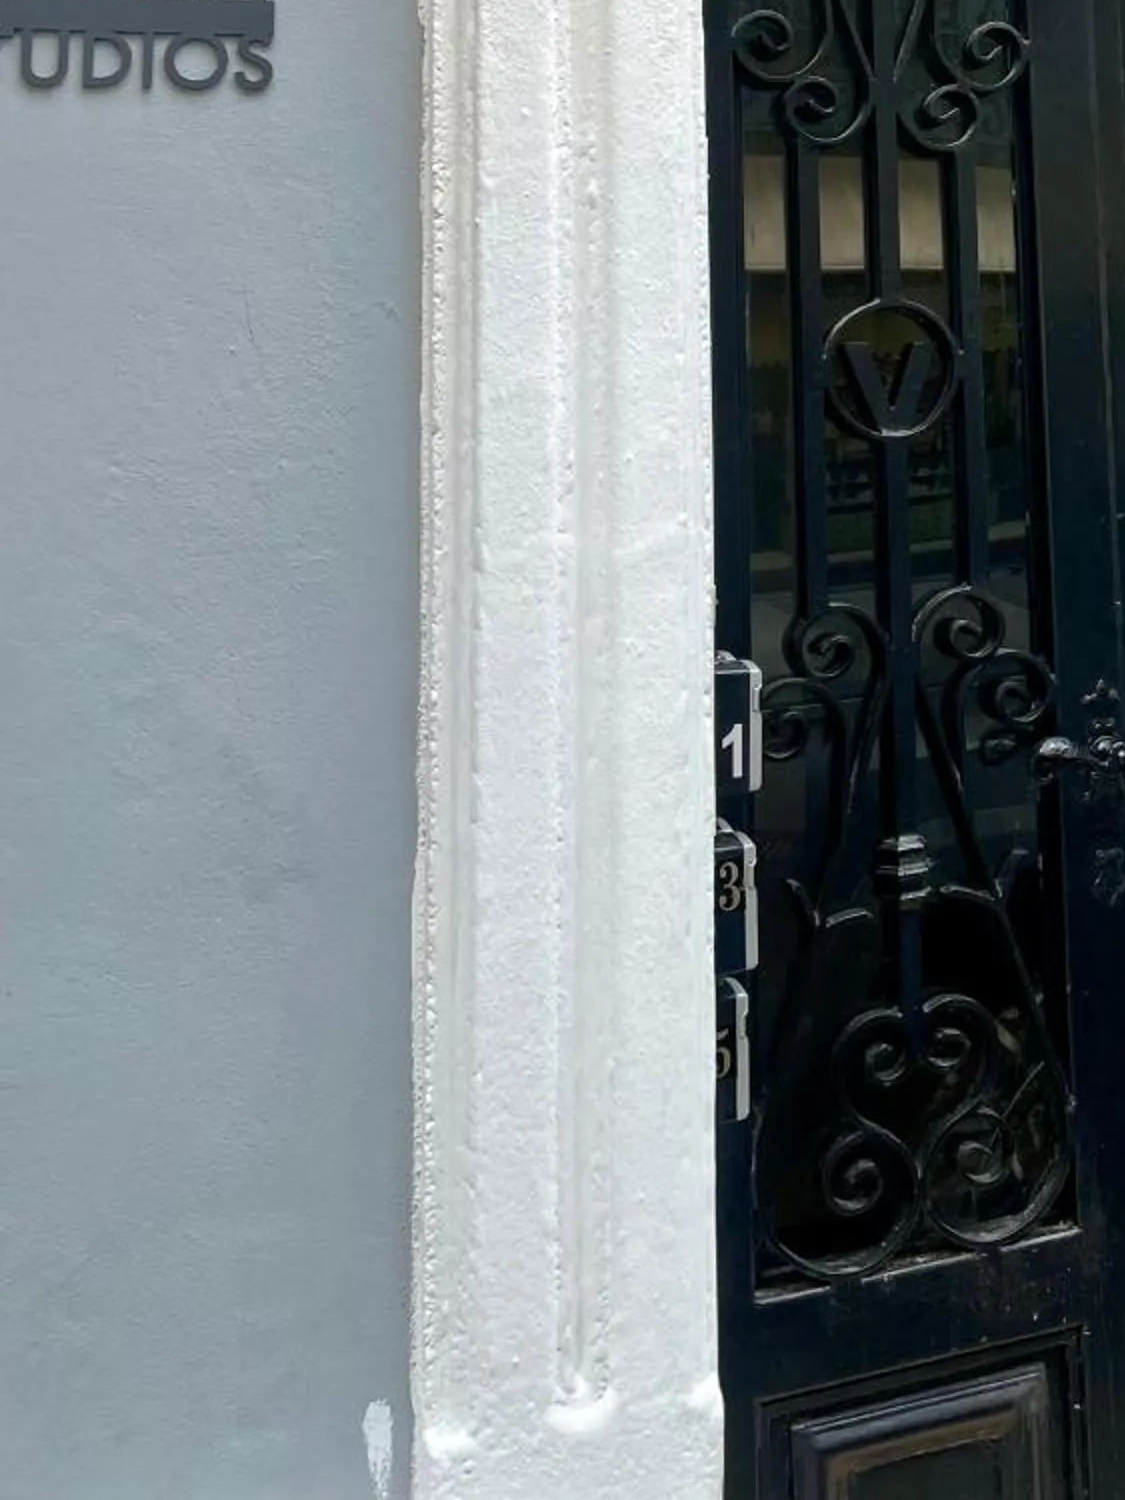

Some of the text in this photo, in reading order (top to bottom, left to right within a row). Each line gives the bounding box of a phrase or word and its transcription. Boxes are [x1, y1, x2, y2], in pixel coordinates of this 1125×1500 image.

[0, 27, 274, 92] UDIOS
[721, 723, 743, 778] 1
[718, 861, 742, 912] 3
